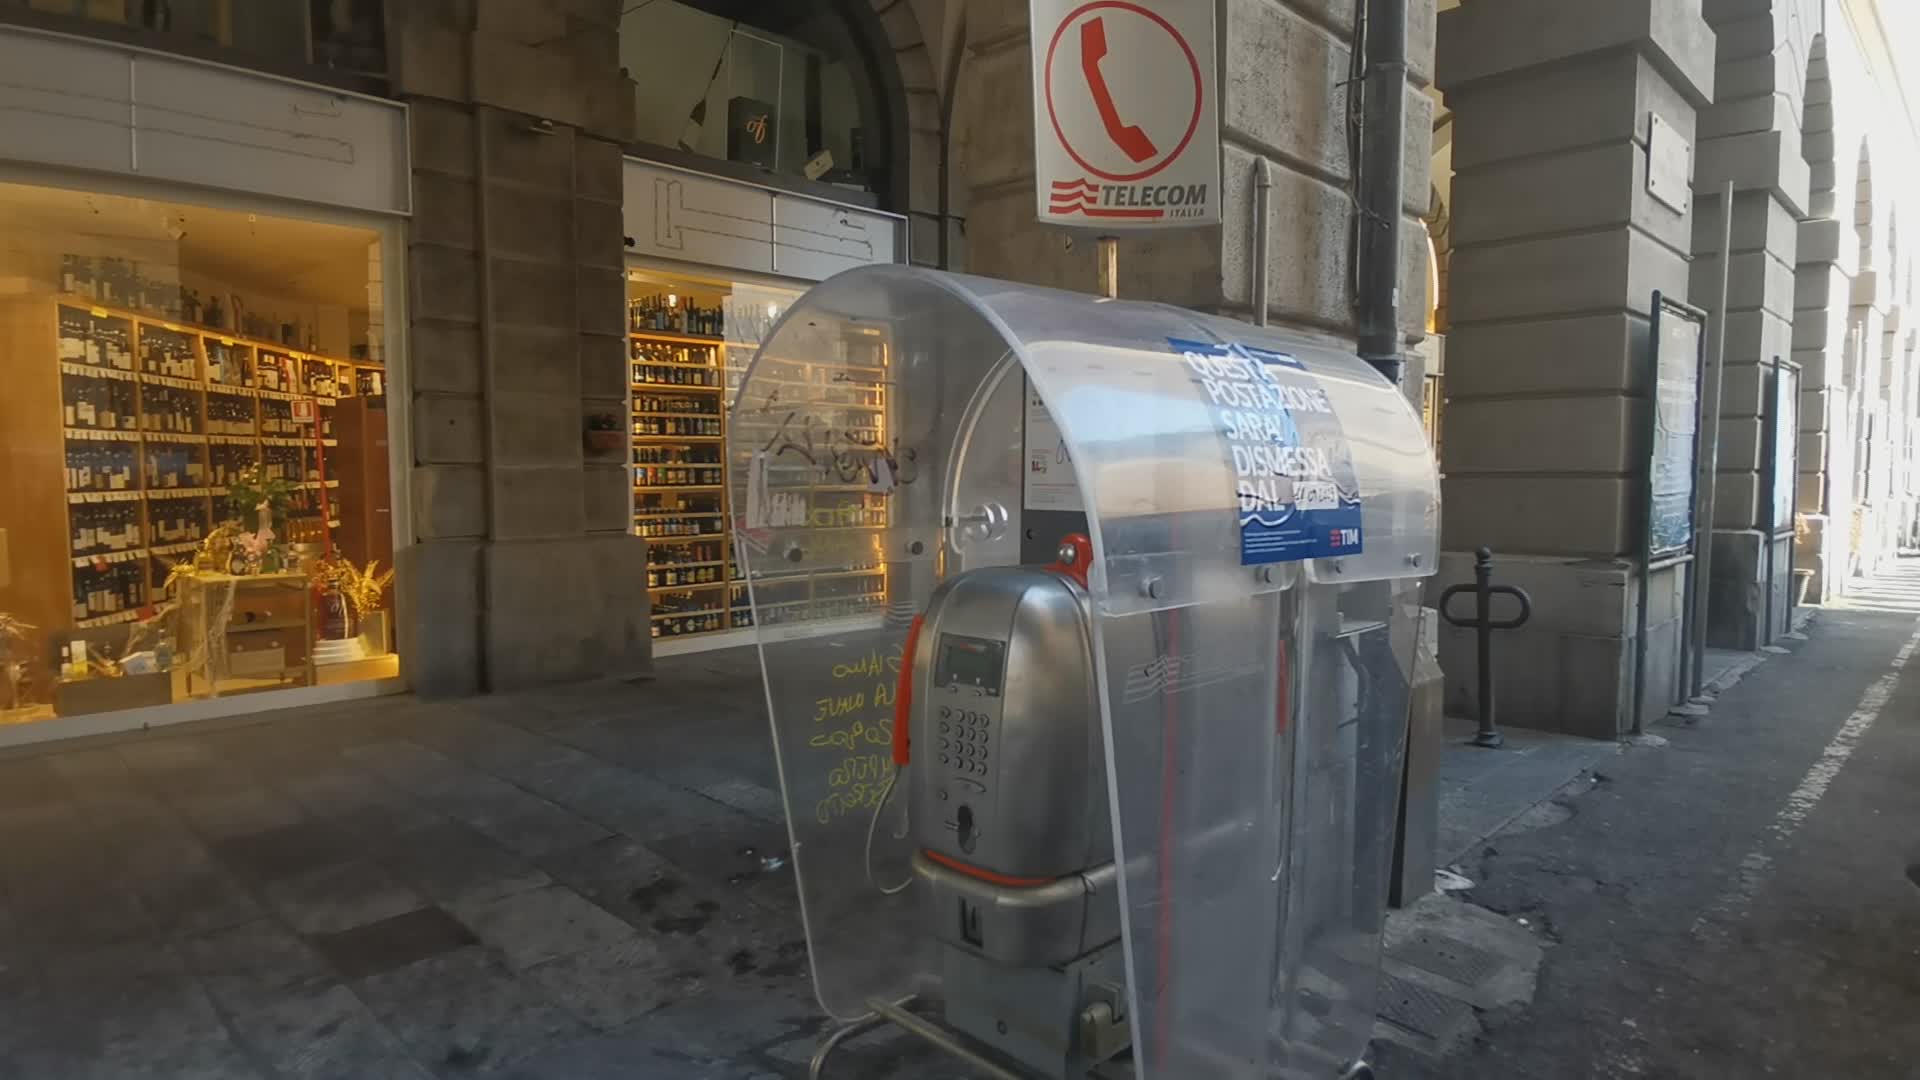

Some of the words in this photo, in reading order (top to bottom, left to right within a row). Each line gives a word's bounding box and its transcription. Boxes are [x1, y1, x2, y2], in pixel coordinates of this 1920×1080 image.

[1102, 184, 1207, 206] TELECOM
[1169, 208, 1205, 218] ITALIA
[1184, 351, 1279, 382] QUESTA
[1202, 378, 1332, 414] POSTAZIONE
[1232, 446, 1333, 477] DISMESSA
[1238, 479, 1286, 513] DAL
[1340, 528, 1360, 545] TIM
